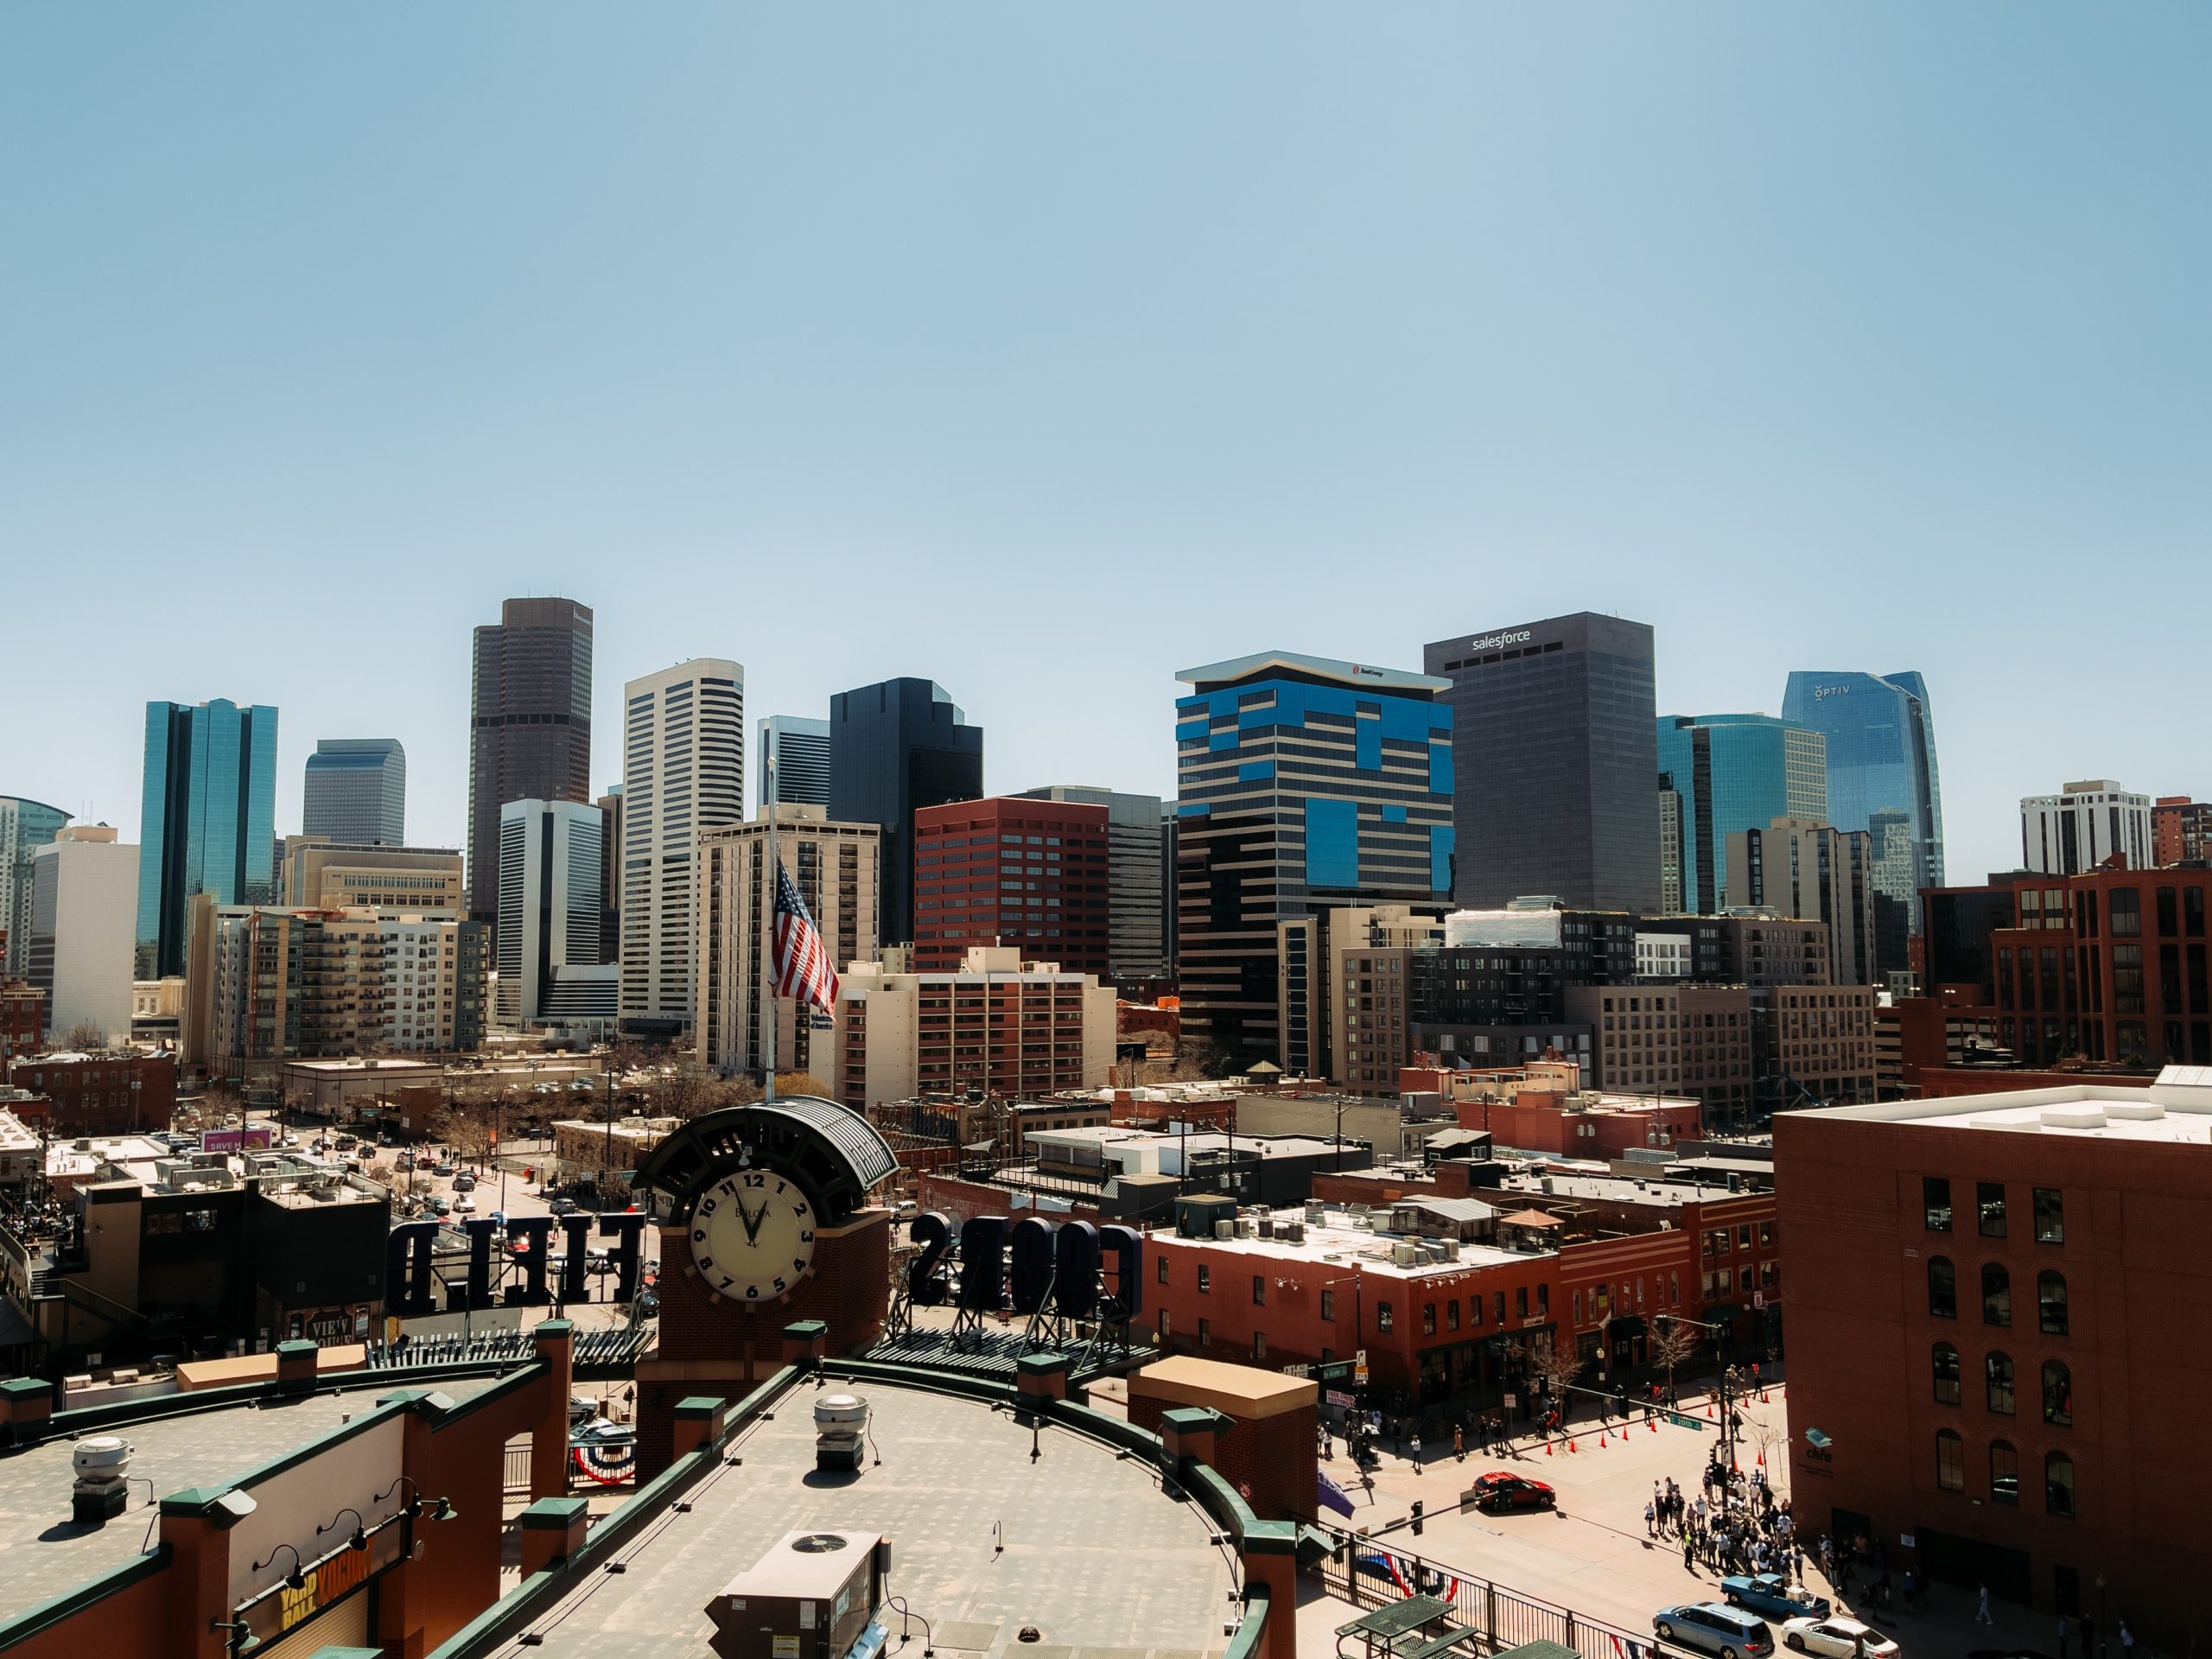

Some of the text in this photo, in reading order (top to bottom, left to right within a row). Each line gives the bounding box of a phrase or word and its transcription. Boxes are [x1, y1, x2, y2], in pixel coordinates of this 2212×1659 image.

[1472, 630, 1531, 651] salesforce
[1815, 684, 1851, 698] OPTIV
[210, 1141, 233, 1151] SAVE
[718, 1179, 735, 1197] 11
[743, 1174, 765, 1188] 12
[776, 1181, 786, 1195] 1
[698, 1198, 717, 1218] 10
[792, 1202, 808, 1217] 2
[693, 1229, 707, 1243] 9
[801, 1230, 814, 1243] 3
[699, 1256, 714, 1271] 8
[793, 1258, 806, 1273] 4
[719, 1275, 734, 1290] 7
[773, 1276, 785, 1293] 5
[746, 1285, 759, 1298] 6
[313, 1319, 349, 1338] VIEW
[1677, 1418, 1693, 1428] 20th
[282, 1593, 317, 1631] BALL
